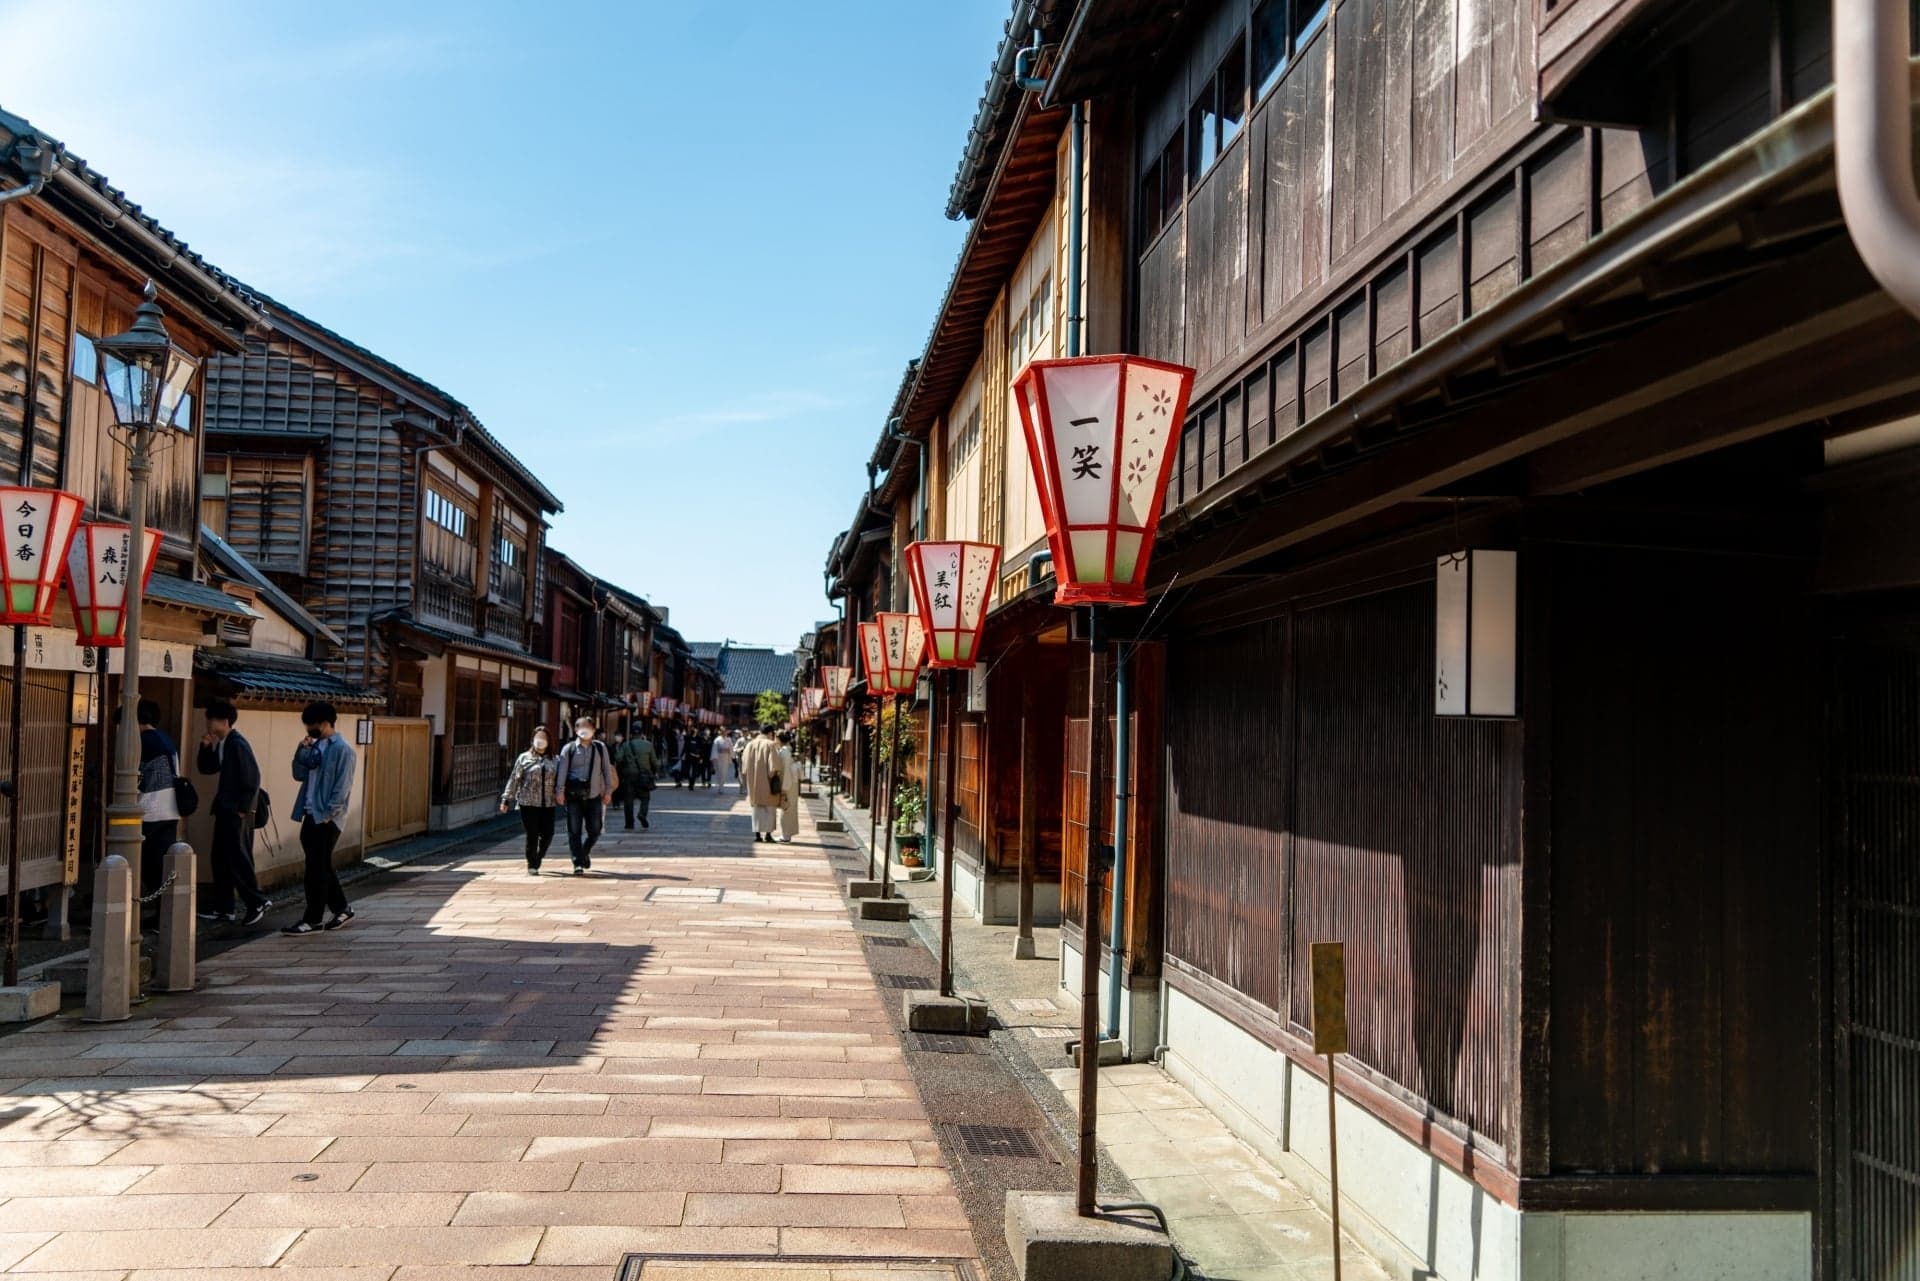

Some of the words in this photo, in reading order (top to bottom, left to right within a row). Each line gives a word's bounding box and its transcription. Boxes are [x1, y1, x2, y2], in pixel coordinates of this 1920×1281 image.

[1070, 416, 1103, 481] 一笑
[16, 500, 37, 562] 今日香
[99, 546, 118, 585] 森八
[934, 570, 952, 610] 美紅
